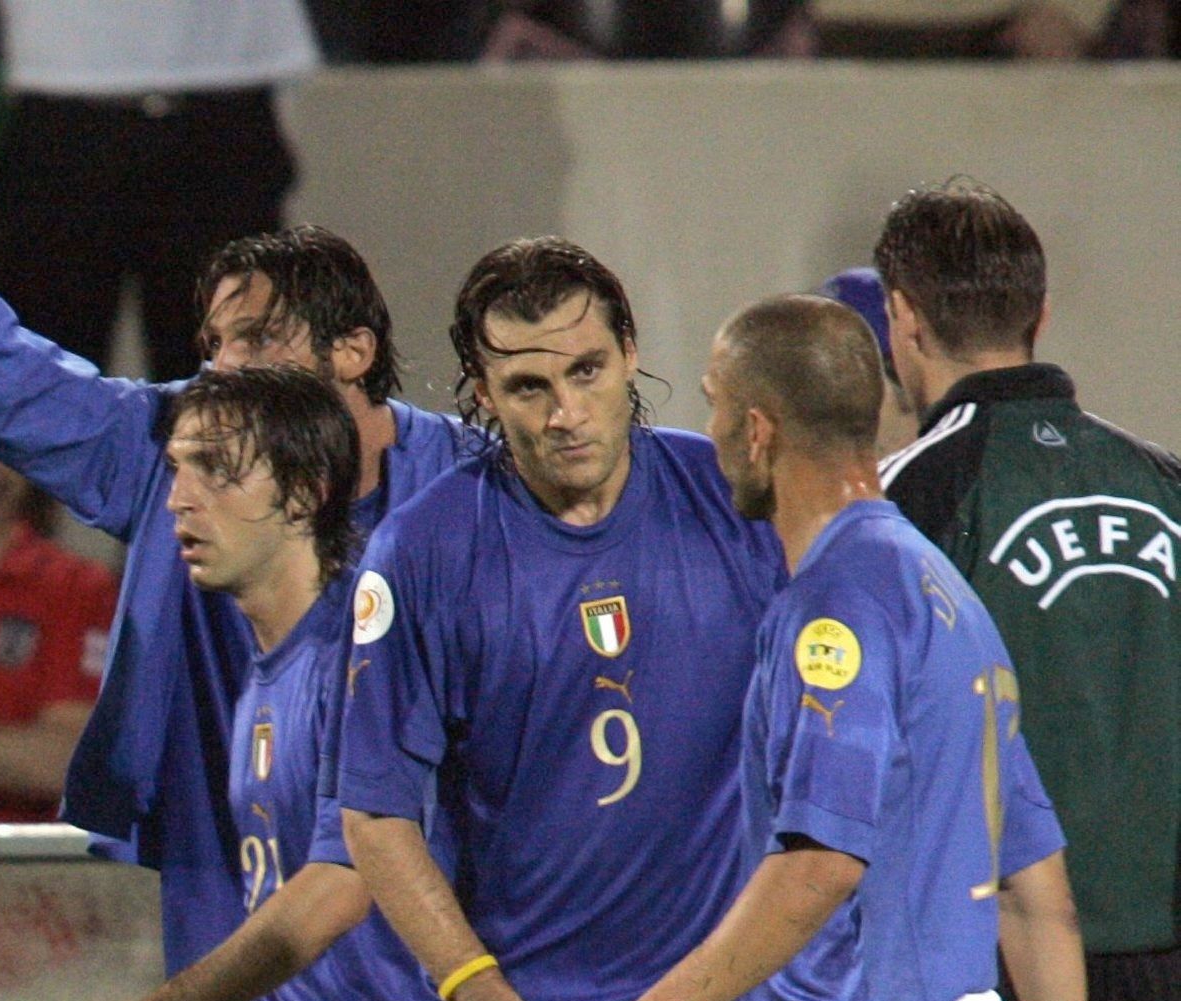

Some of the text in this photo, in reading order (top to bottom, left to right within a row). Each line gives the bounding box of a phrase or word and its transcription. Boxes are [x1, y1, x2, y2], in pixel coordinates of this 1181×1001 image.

[1008, 515, 1176, 586] UEFA
[586, 602, 622, 617] ITALIA
[590, 709, 641, 807] 9
